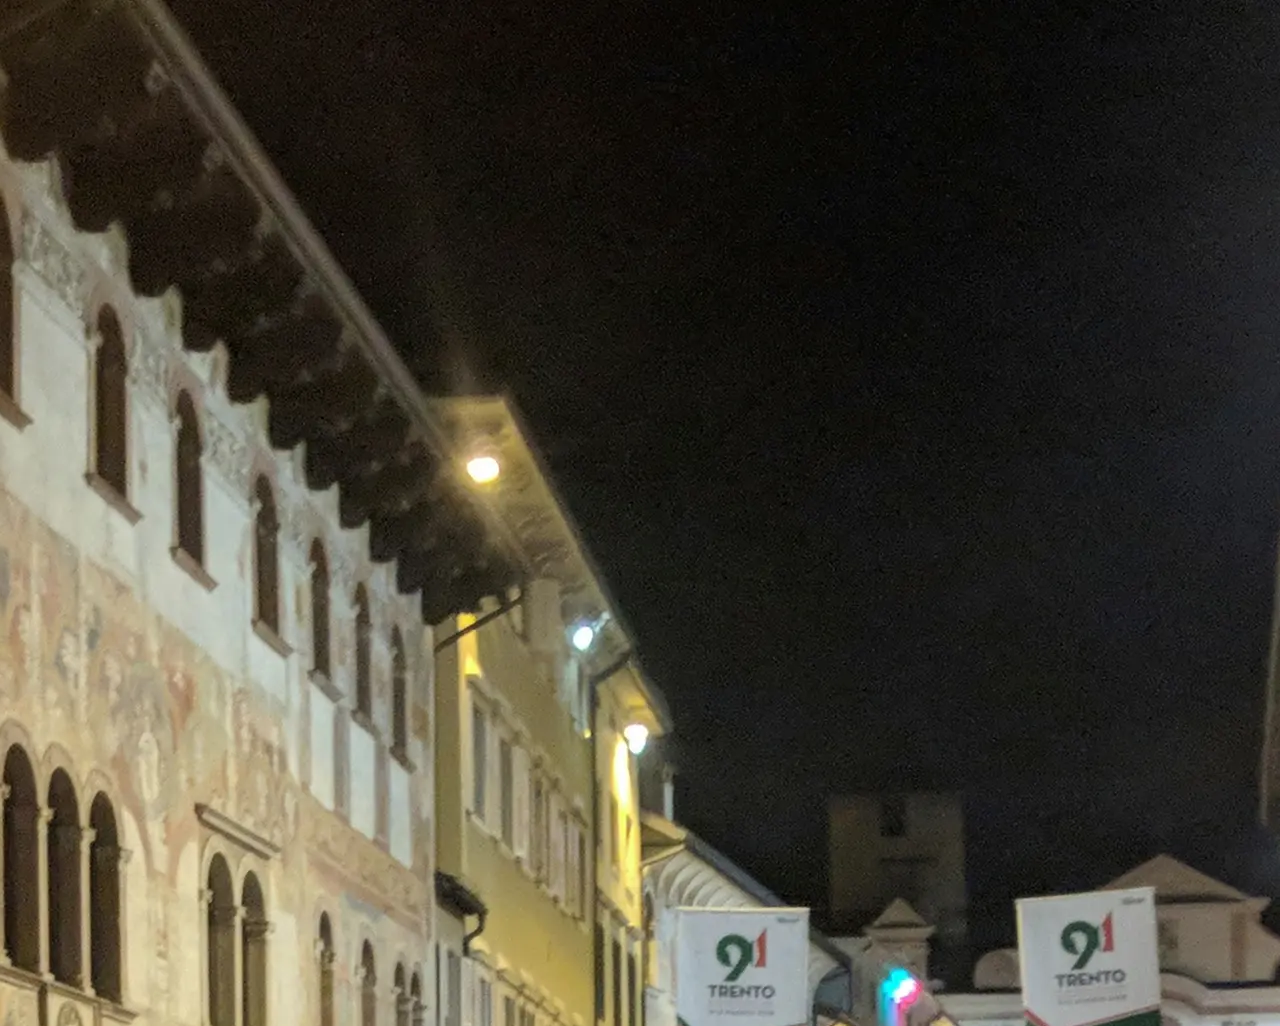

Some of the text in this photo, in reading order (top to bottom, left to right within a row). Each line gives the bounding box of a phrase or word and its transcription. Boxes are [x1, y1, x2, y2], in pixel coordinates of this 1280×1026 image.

[716, 928, 767, 982] 91
[1061, 910, 1115, 971] 91
[706, 984, 776, 999] TRENTO
[1054, 968, 1127, 988] TRENTO
